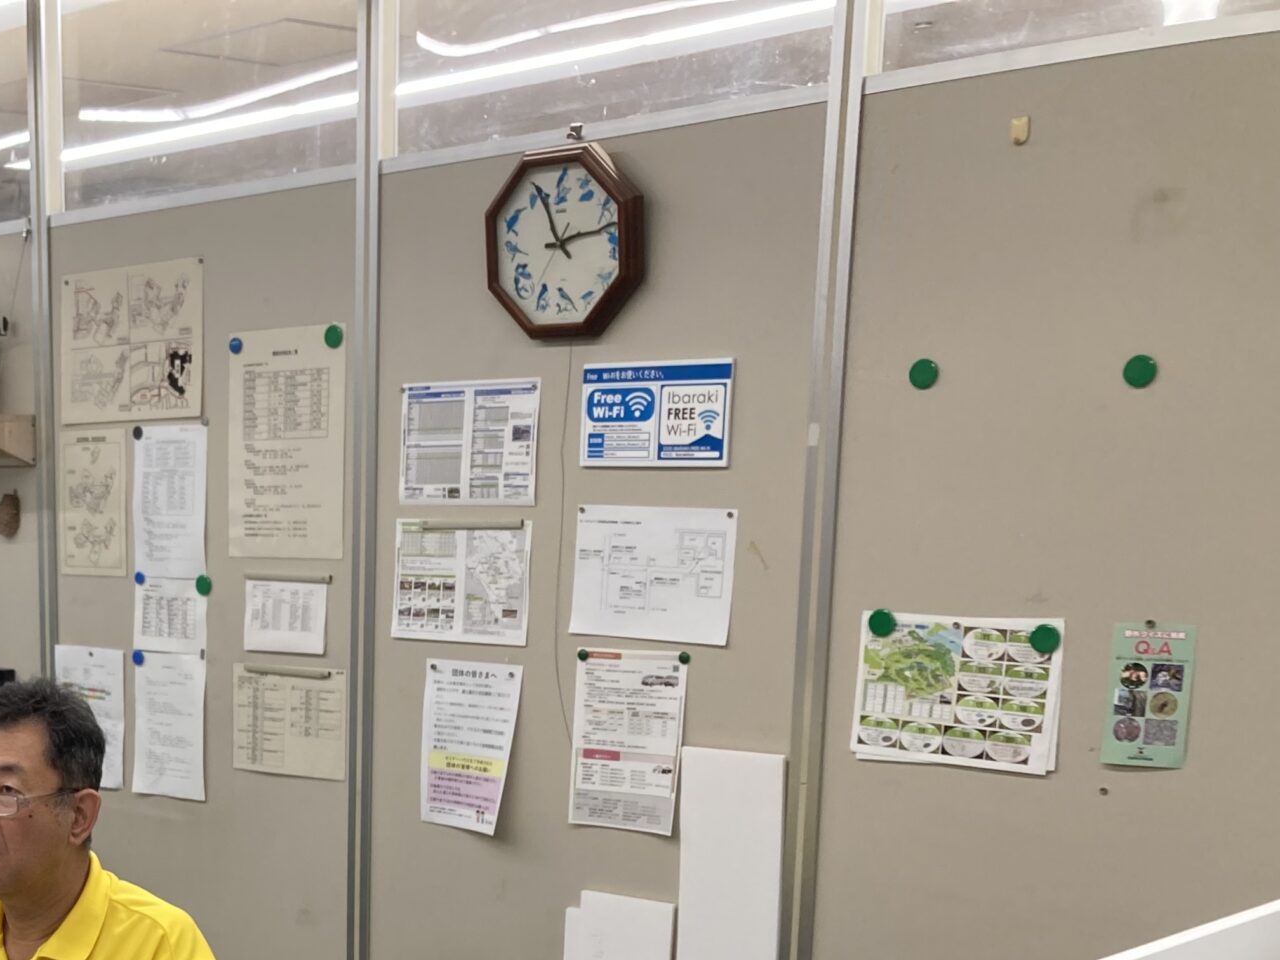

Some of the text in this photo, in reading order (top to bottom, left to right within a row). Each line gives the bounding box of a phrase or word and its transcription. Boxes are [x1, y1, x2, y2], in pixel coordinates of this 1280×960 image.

[594, 392, 622, 404] Free
[667, 390, 719, 405] Ibaraki
[593, 406, 625, 418] Wi-Fi
[667, 408, 696, 421] FREE
[666, 423, 697, 437] Wi-Fi
